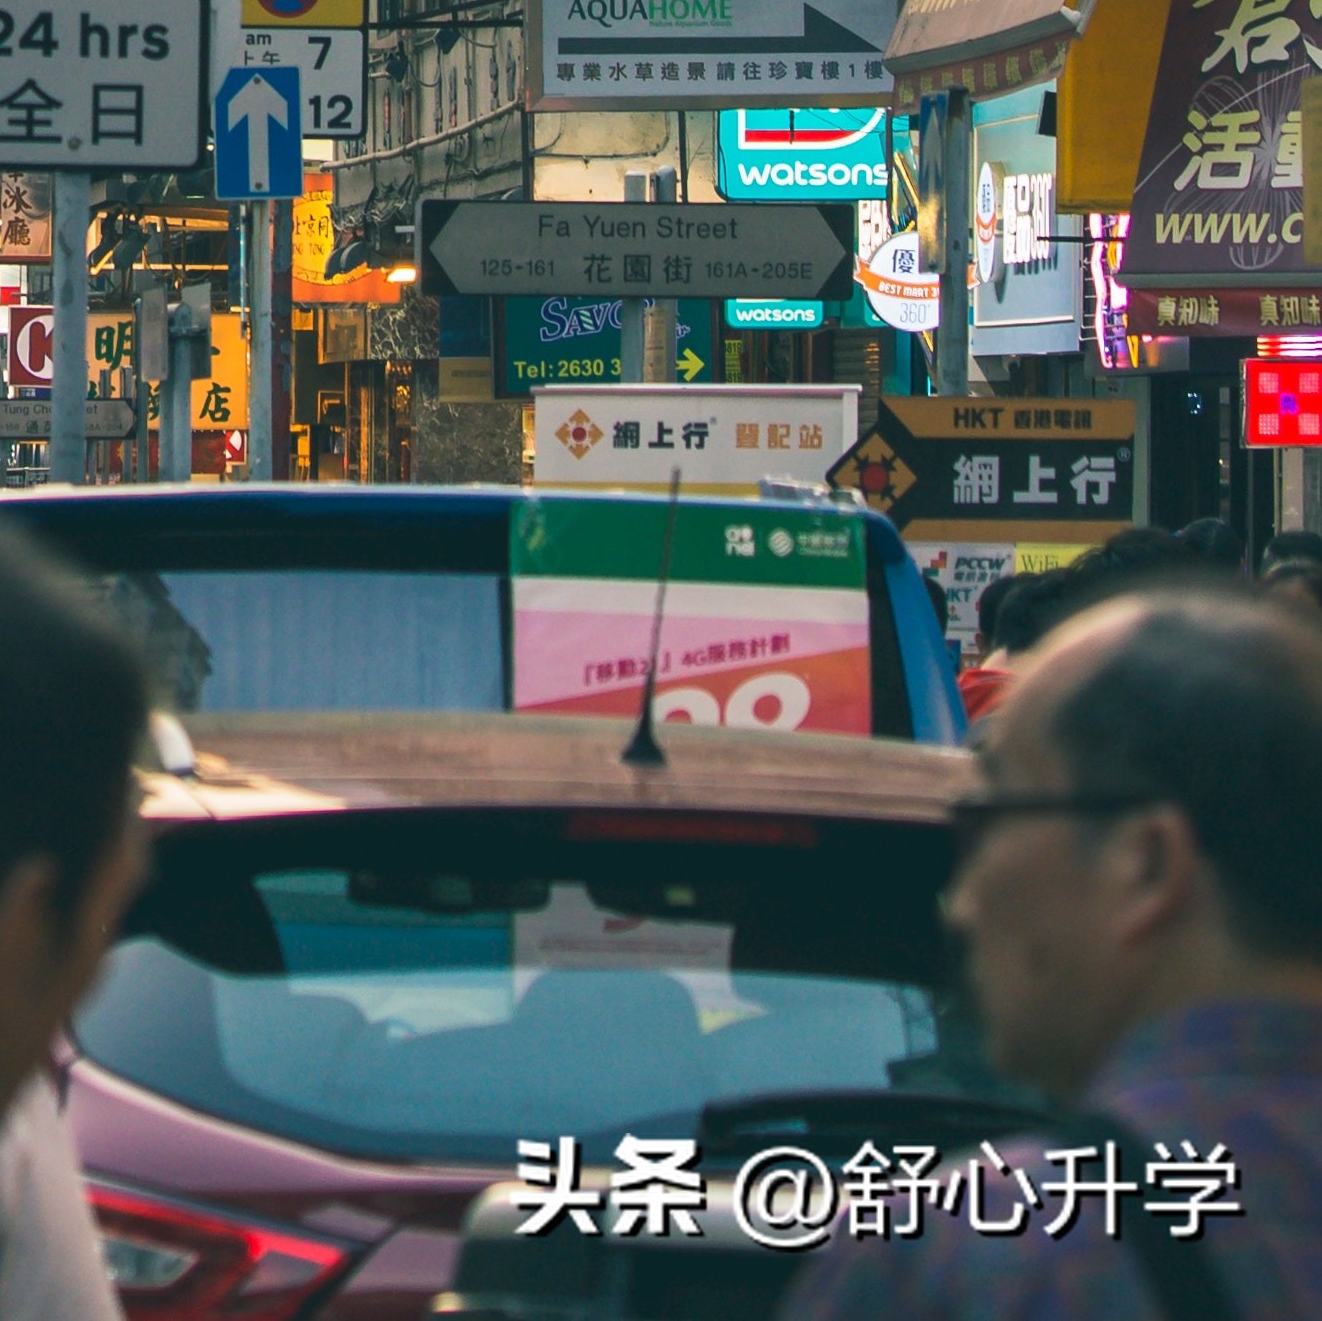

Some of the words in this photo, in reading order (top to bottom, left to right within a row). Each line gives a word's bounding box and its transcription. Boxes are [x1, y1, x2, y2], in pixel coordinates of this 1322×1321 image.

[78, 12, 170, 61] hrs
[246, 32, 272, 46] am
[308, 36, 332, 71] 7
[557, 60, 706, 82] 專業水草造景
[716, 60, 884, 82] 請往珍寶樓1樓
[309, 95, 353, 130] 12
[738, 160, 889, 186] watsons
[538, 215, 571, 238] Fa
[582, 215, 646, 240] Yuen
[656, 215, 738, 240] Street
[480, 258, 555, 277] 125-161
[583, 253, 693, 285] 花園街
[706, 261, 813, 280] 161A-205E
[878, 282, 903, 295] BEST
[904, 284, 929, 297] MART
[736, 306, 815, 323] watsons
[1157, 295, 1220, 326] 真知味
[1259, 295, 1321, 326] 真知味
[514, 359, 553, 378] Tel:
[558, 359, 604, 377] 2630
[3, 404, 29, 415] Tung
[33, 404, 51, 415] Cho
[953, 408, 1005, 429] HKT
[1014, 408, 1092, 430] 香港電訊
[613, 421, 709, 450] 網上行
[735, 422, 823, 450] 登記站
[954, 455, 1116, 505] 網上行
[955, 557, 1006, 570] PCCW
